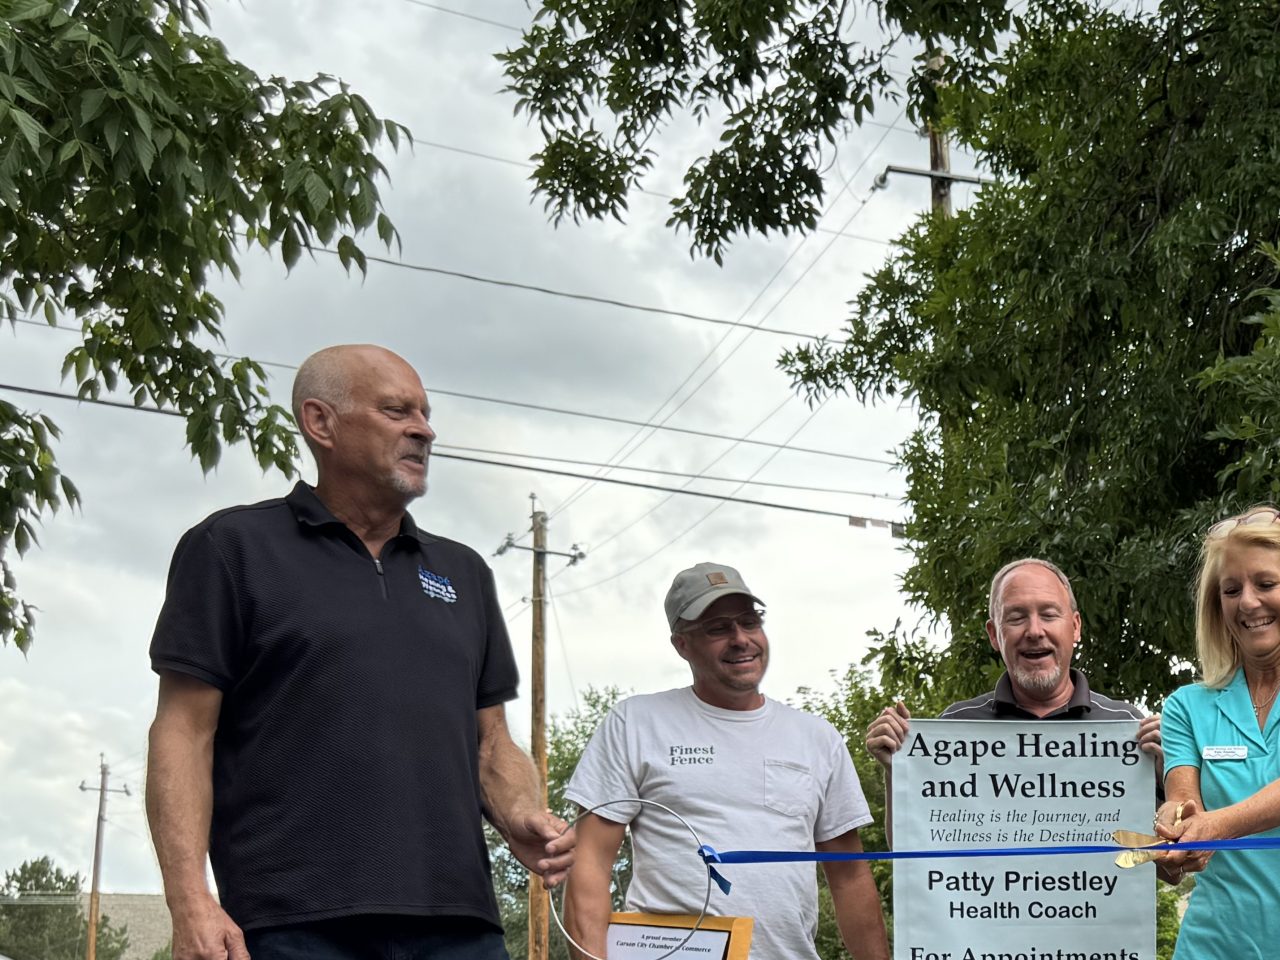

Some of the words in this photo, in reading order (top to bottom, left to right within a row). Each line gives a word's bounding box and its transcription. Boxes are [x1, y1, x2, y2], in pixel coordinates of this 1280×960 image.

[669, 745, 715, 756] Finest
[907, 732, 1006, 765] Agape
[1016, 732, 1140, 766] Healing
[671, 756, 714, 766] Fence
[921, 773, 978, 798] and
[989, 773, 1125, 798] Wellness
[929, 809, 985, 826] Healing
[991, 811, 1001, 822] is
[1006, 809, 1028, 822] the
[1031, 809, 1090, 827] Journey,
[1095, 808, 1121, 822] and
[930, 829, 992, 842] Wellness
[997, 830, 1009, 842] is
[1013, 829, 1034, 842] the
[1039, 829, 1115, 842] Destinatio
[928, 870, 995, 896] Patty
[1004, 870, 1118, 896] Priestley
[949, 901, 1020, 919] Health
[1027, 901, 1097, 919] Coach
